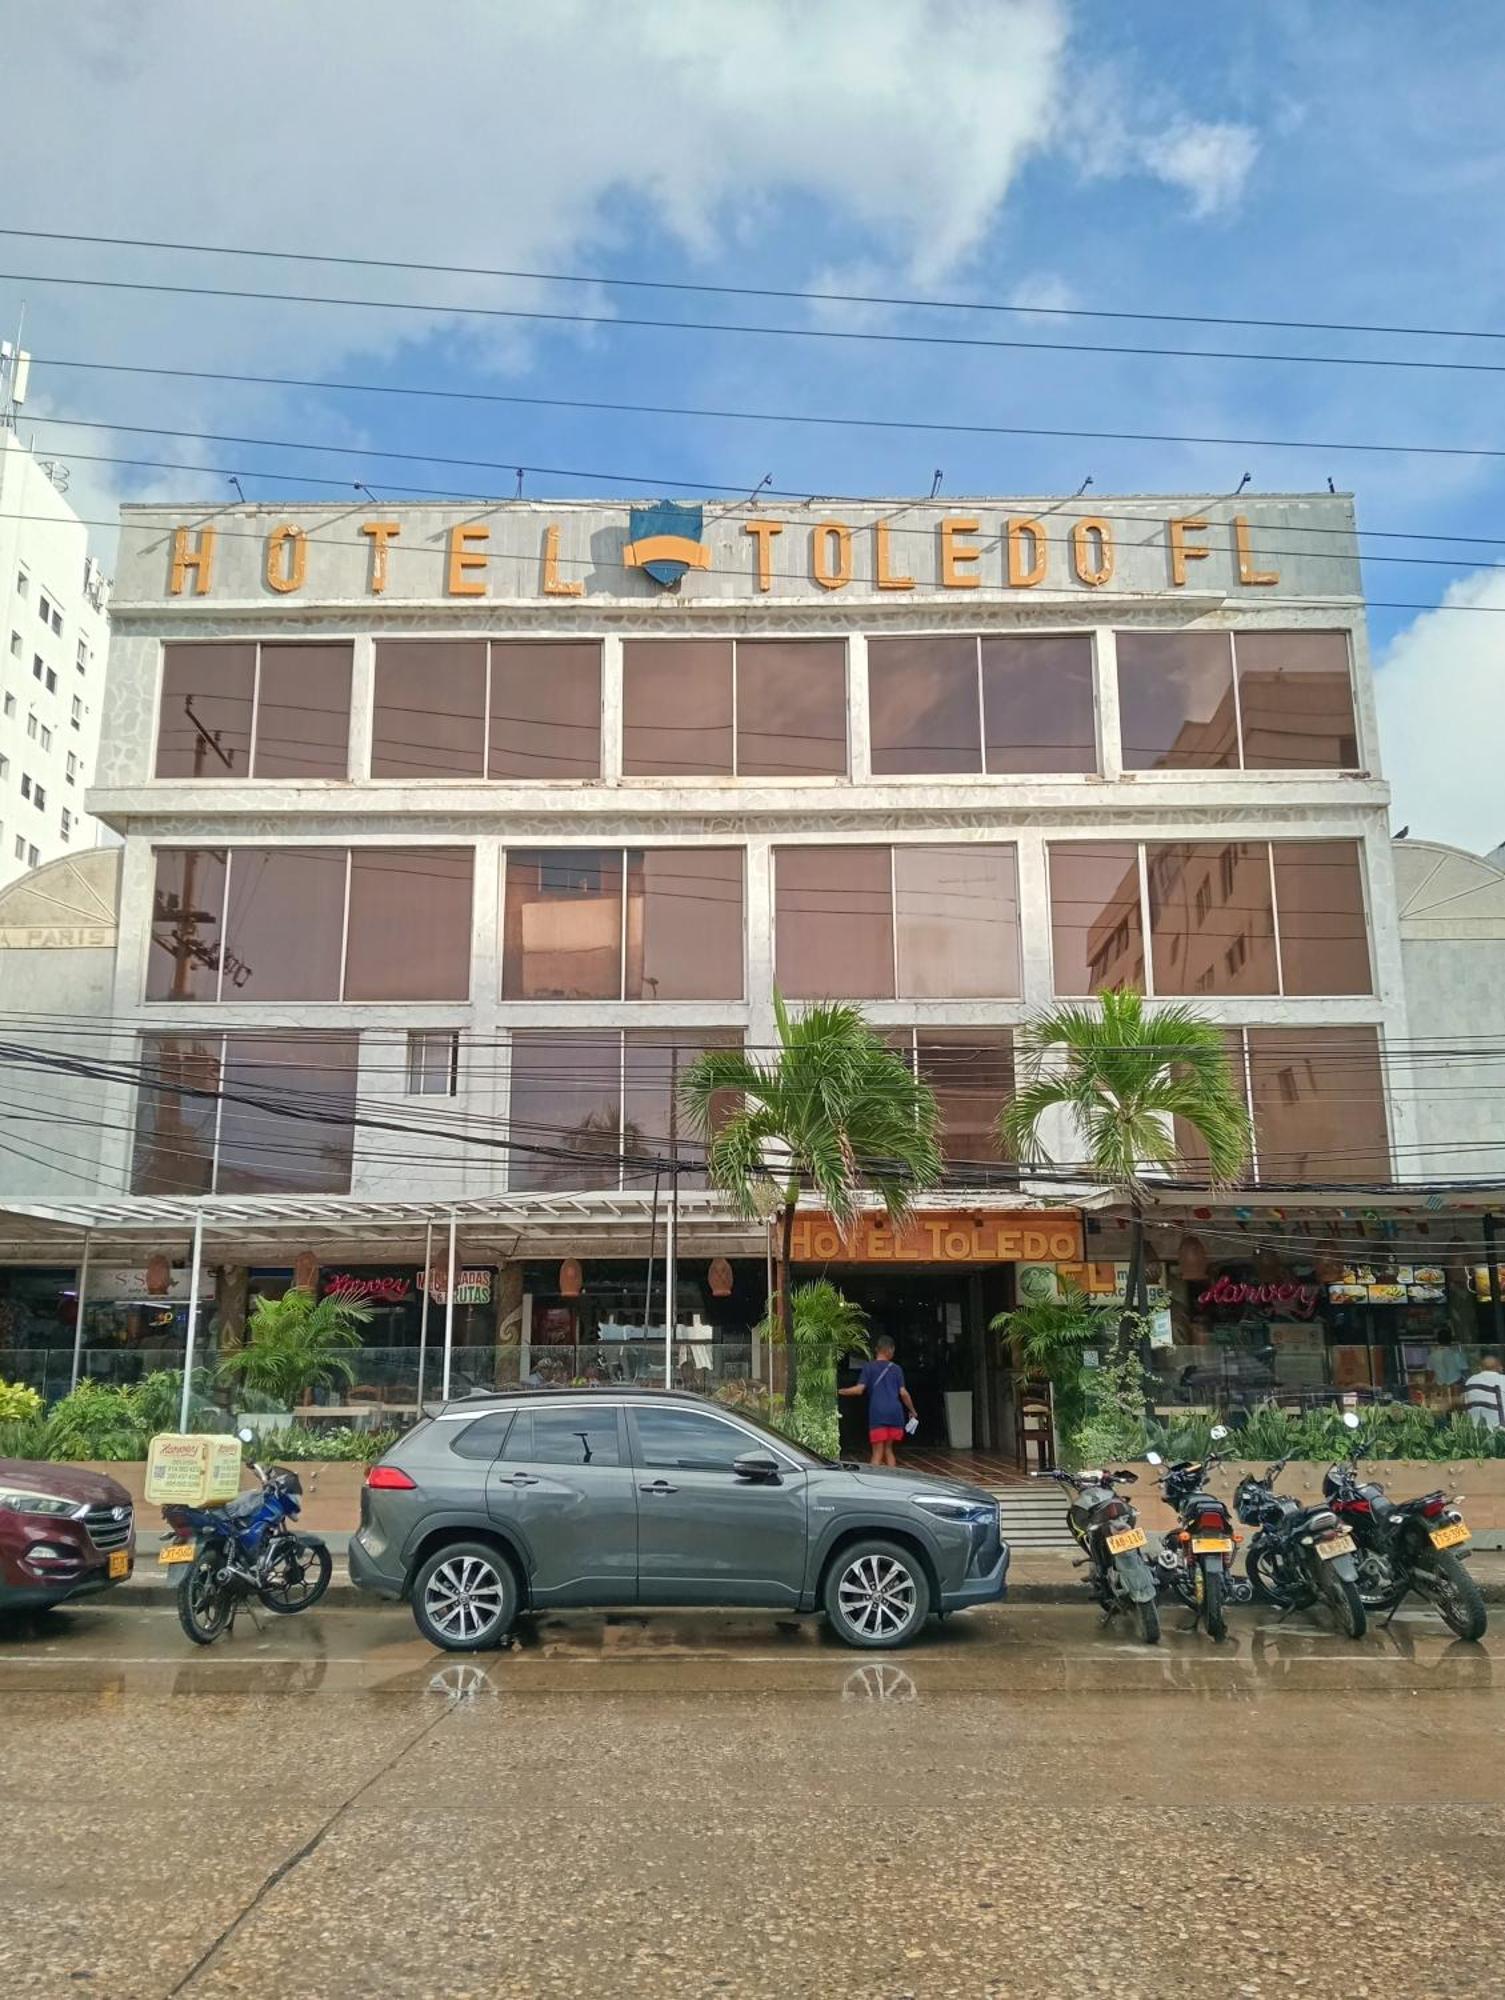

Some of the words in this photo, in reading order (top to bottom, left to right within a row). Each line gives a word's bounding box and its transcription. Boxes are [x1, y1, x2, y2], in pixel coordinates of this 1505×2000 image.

[169, 522, 587, 596] HOTEL
[745, 516, 1115, 592] TOLEDO
[1168, 515, 1280, 587] FL
[27, 929, 105, 946] PARIS
[924, 1221, 1076, 1259] TOLEDO
